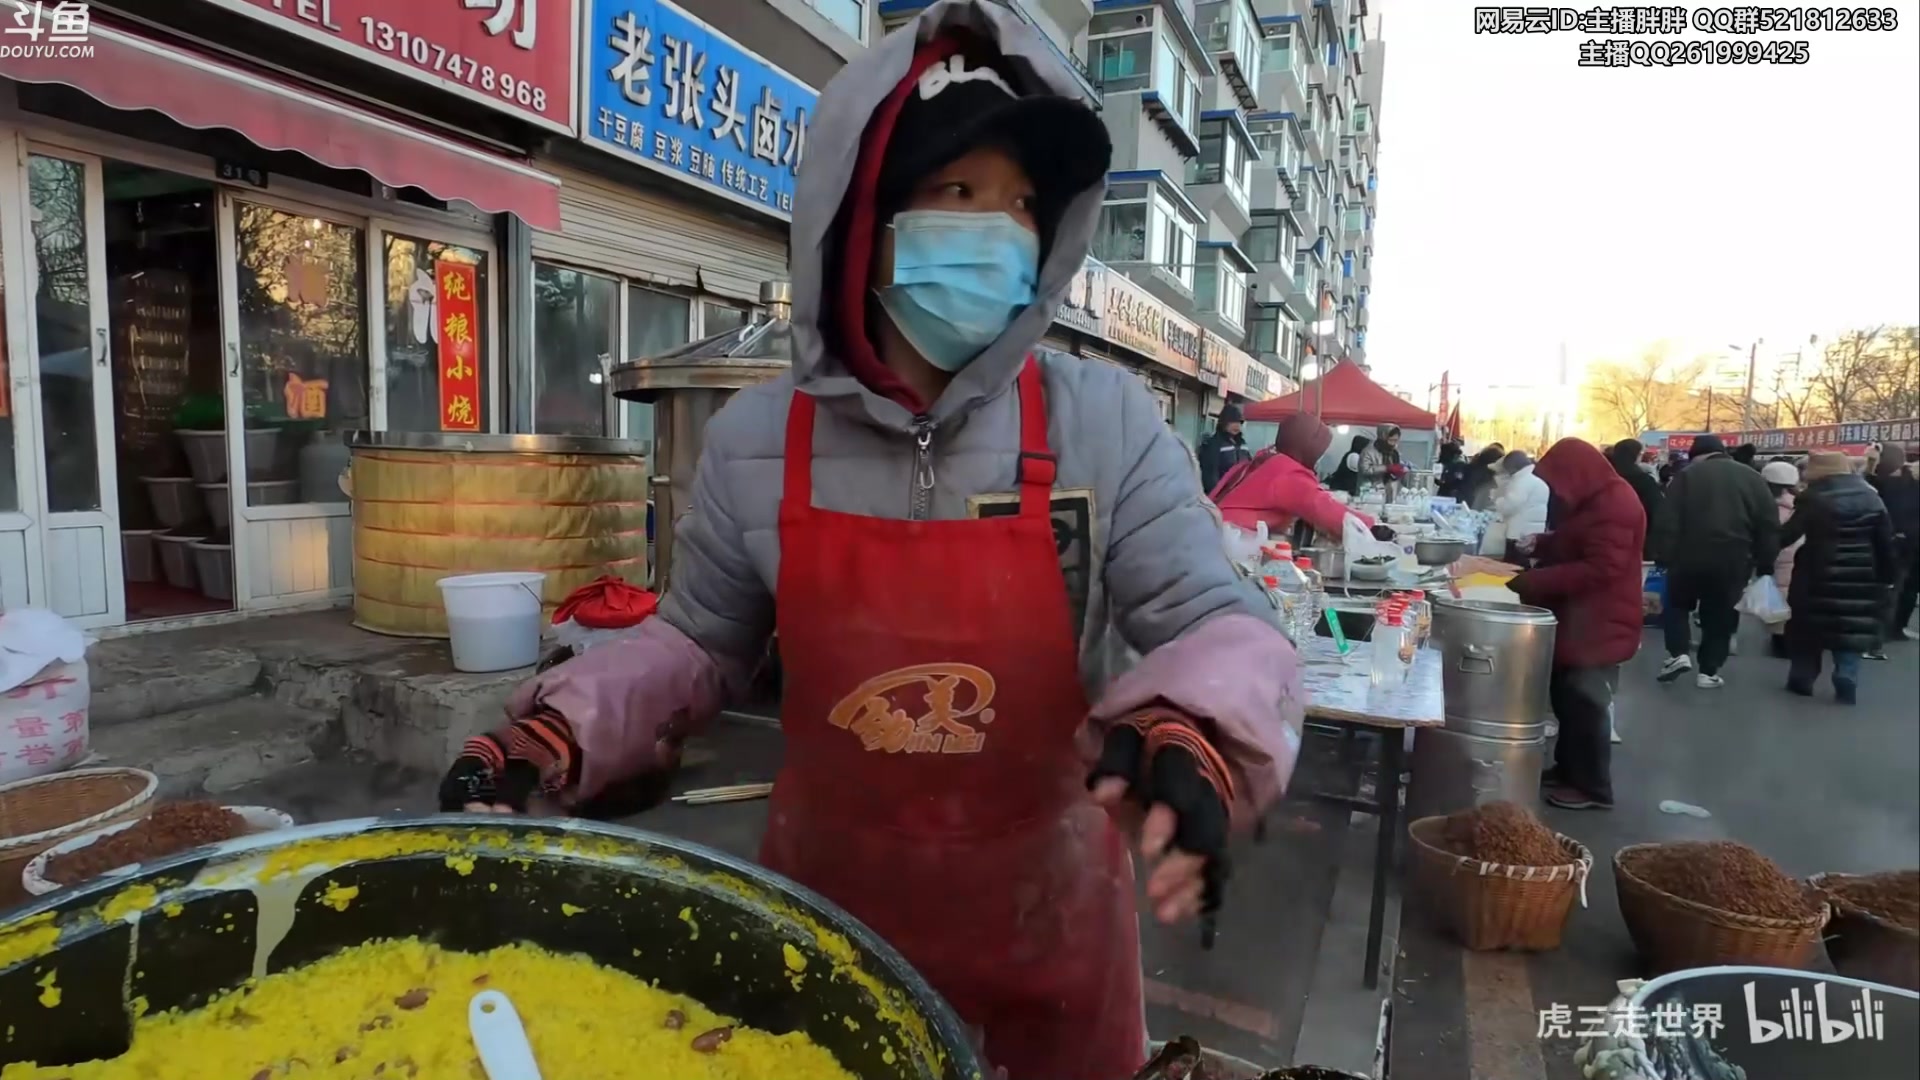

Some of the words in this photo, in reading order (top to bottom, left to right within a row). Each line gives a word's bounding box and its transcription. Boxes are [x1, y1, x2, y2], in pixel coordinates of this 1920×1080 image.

[360, 15, 547, 112] 13107478968
[598, 106, 645, 152] 干豆腐
[654, 131, 684, 166] 豆浆
[721, 159, 769, 202] 传统工艺
[284, 372, 329, 418] 酒
[442, 270, 476, 426] 纯粮小烧
